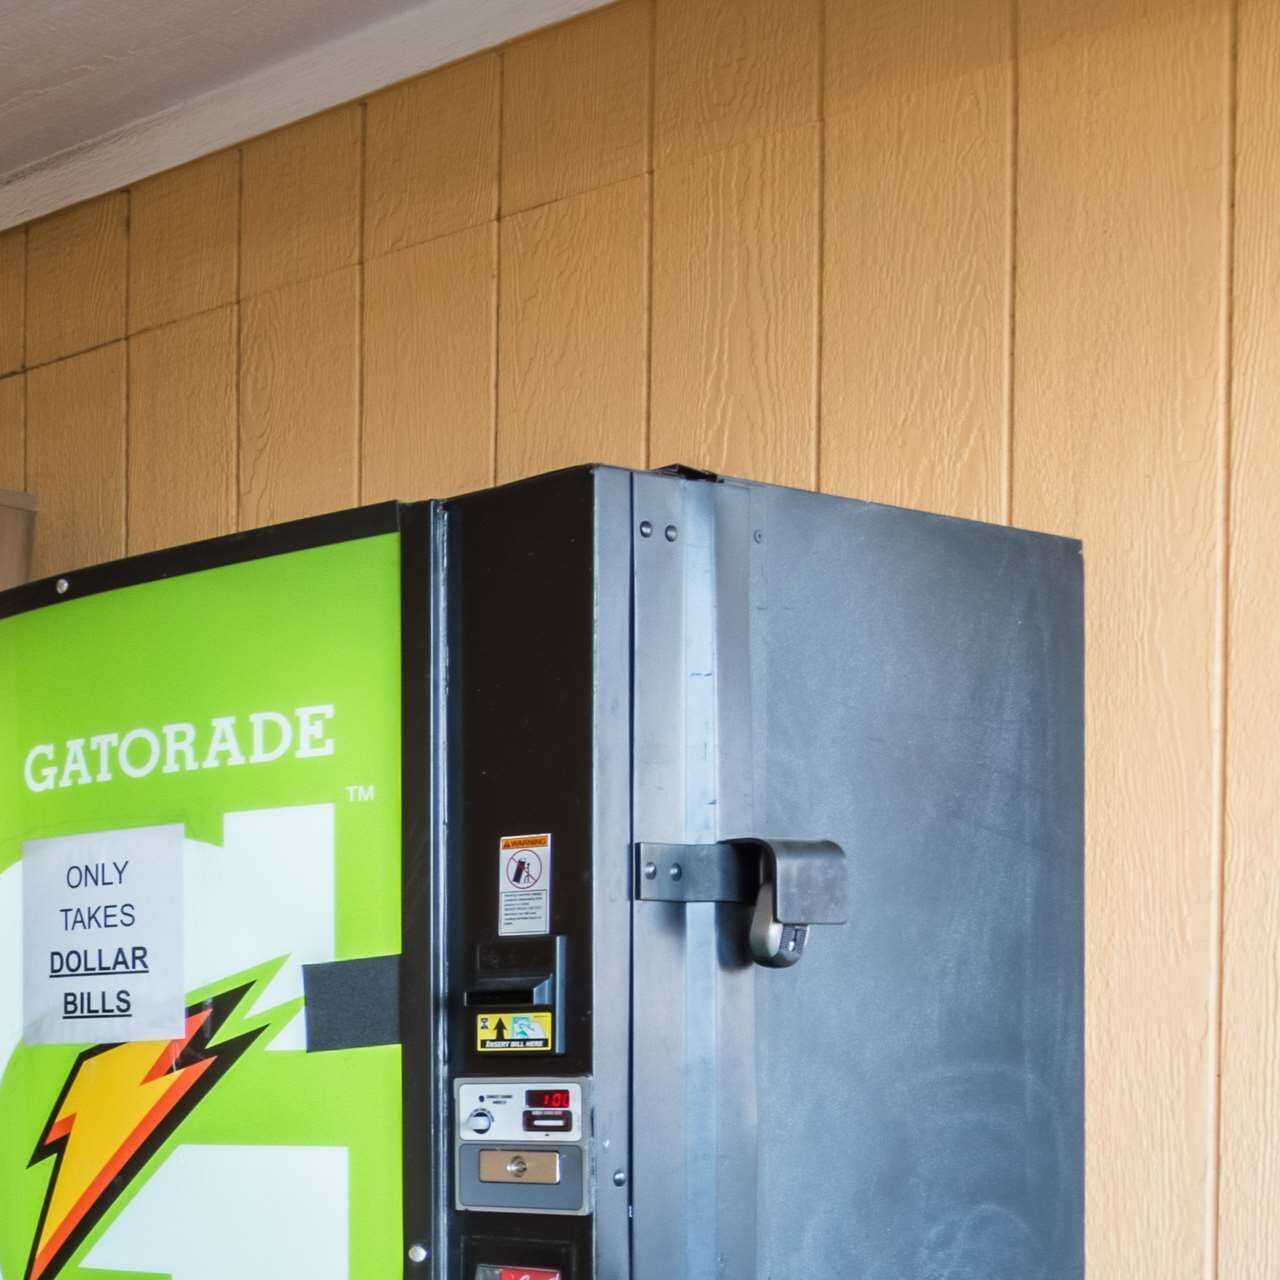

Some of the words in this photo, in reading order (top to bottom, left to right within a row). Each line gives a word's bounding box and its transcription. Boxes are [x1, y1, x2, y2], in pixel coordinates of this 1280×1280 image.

[24, 704, 335, 792] GATORADE
[346, 785, 375, 802] TM
[66, 861, 130, 889] ONLY
[60, 903, 136, 931] TAKES
[49, 946, 149, 975] DOLLAR
[63, 990, 132, 1017] BILLS
